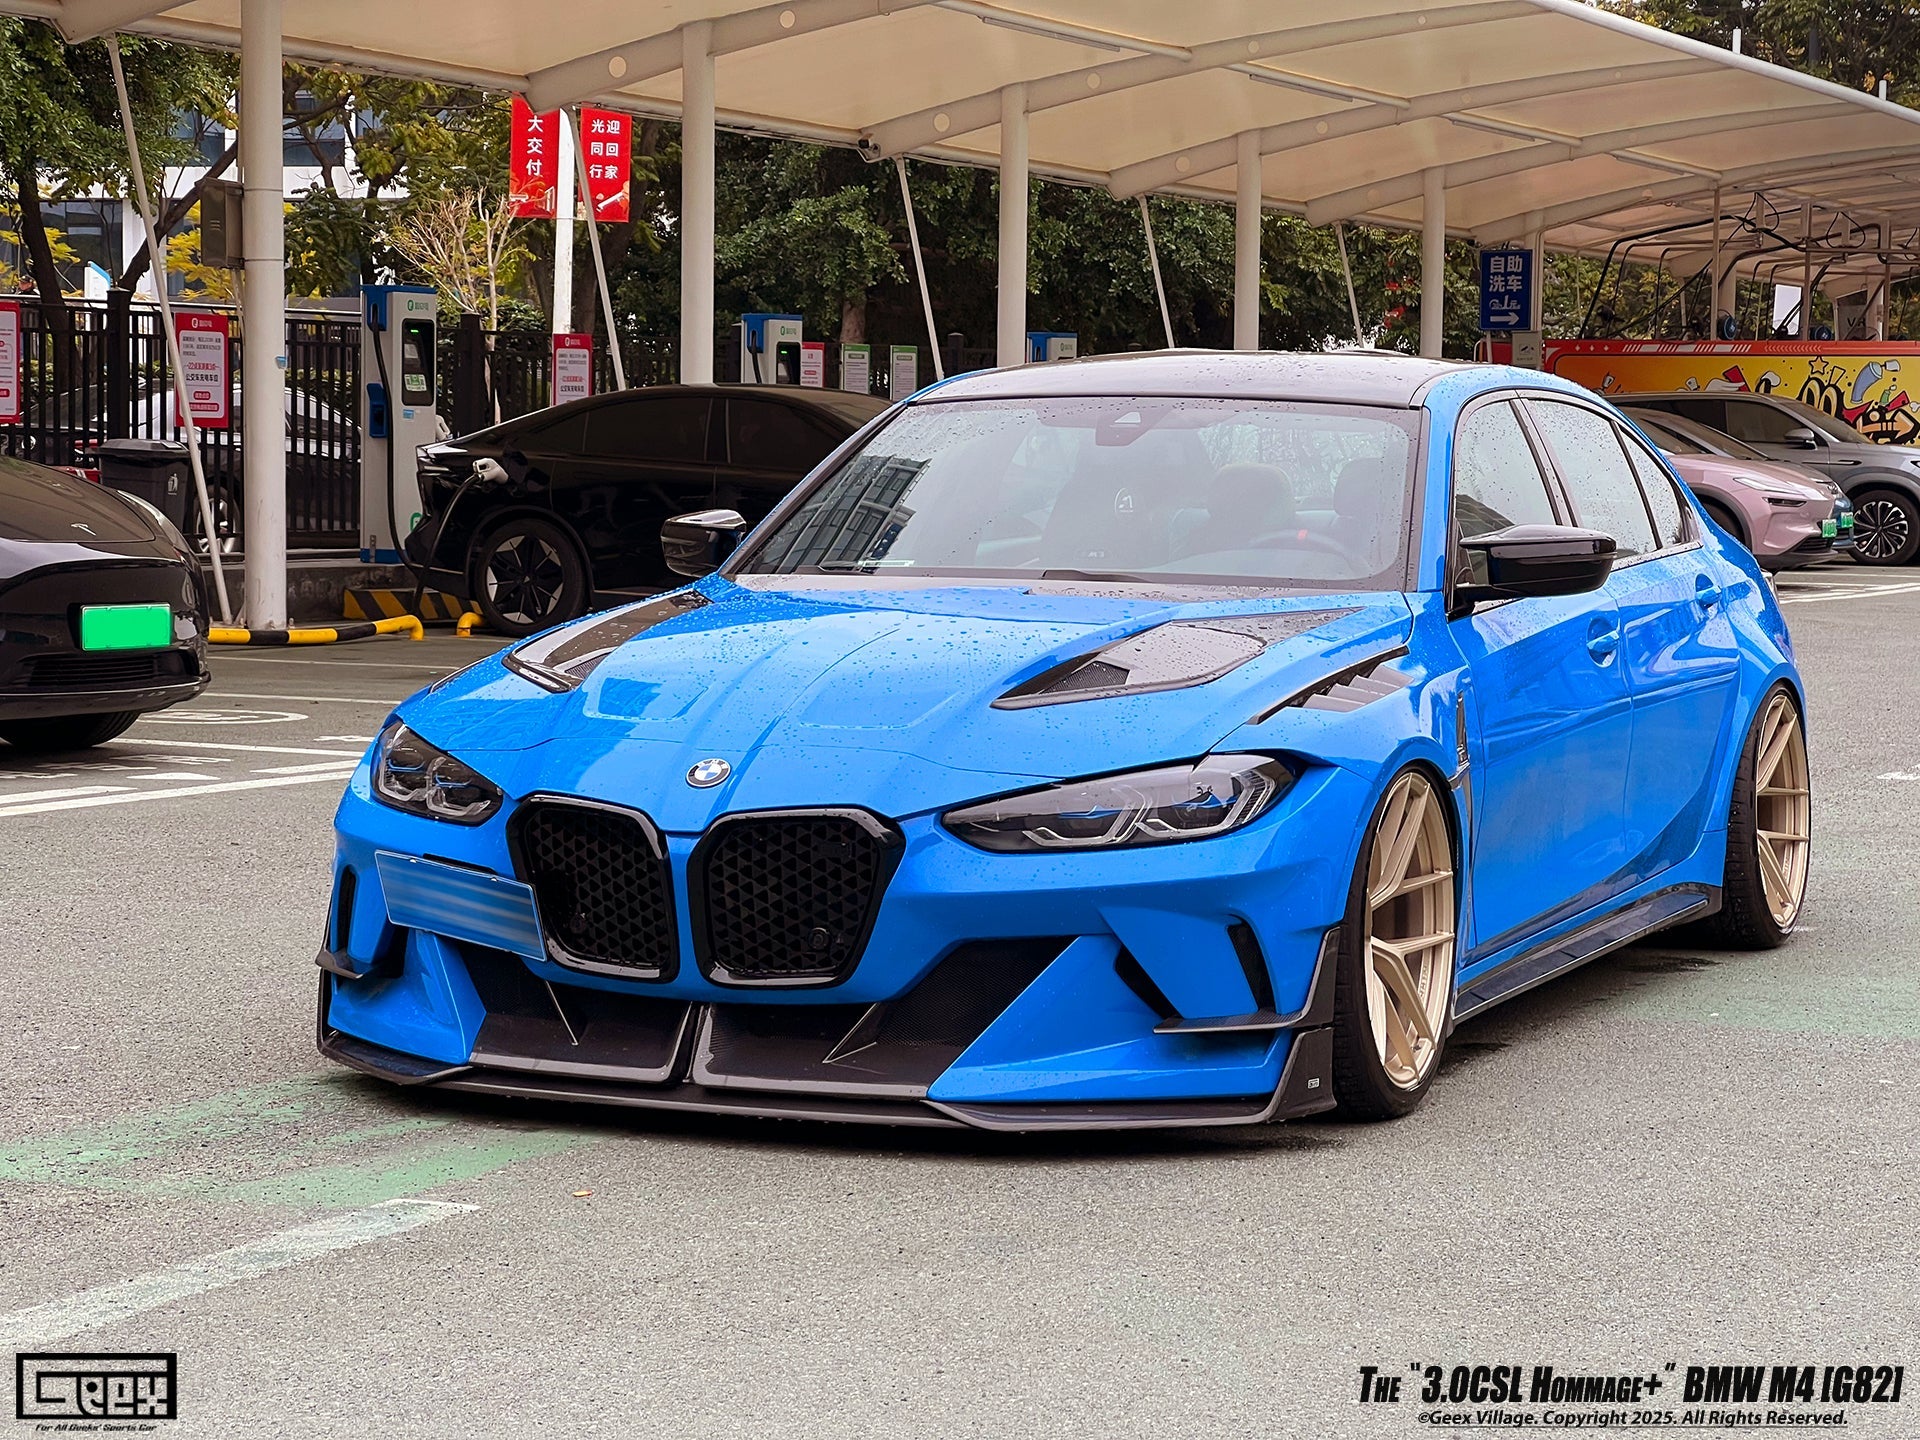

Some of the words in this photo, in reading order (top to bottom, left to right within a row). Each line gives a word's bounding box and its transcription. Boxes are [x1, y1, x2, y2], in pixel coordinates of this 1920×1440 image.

[526, 115, 543, 176] 大交付
[1490, 255, 1523, 273] 自助
[1489, 275, 1522, 292] 洗车
